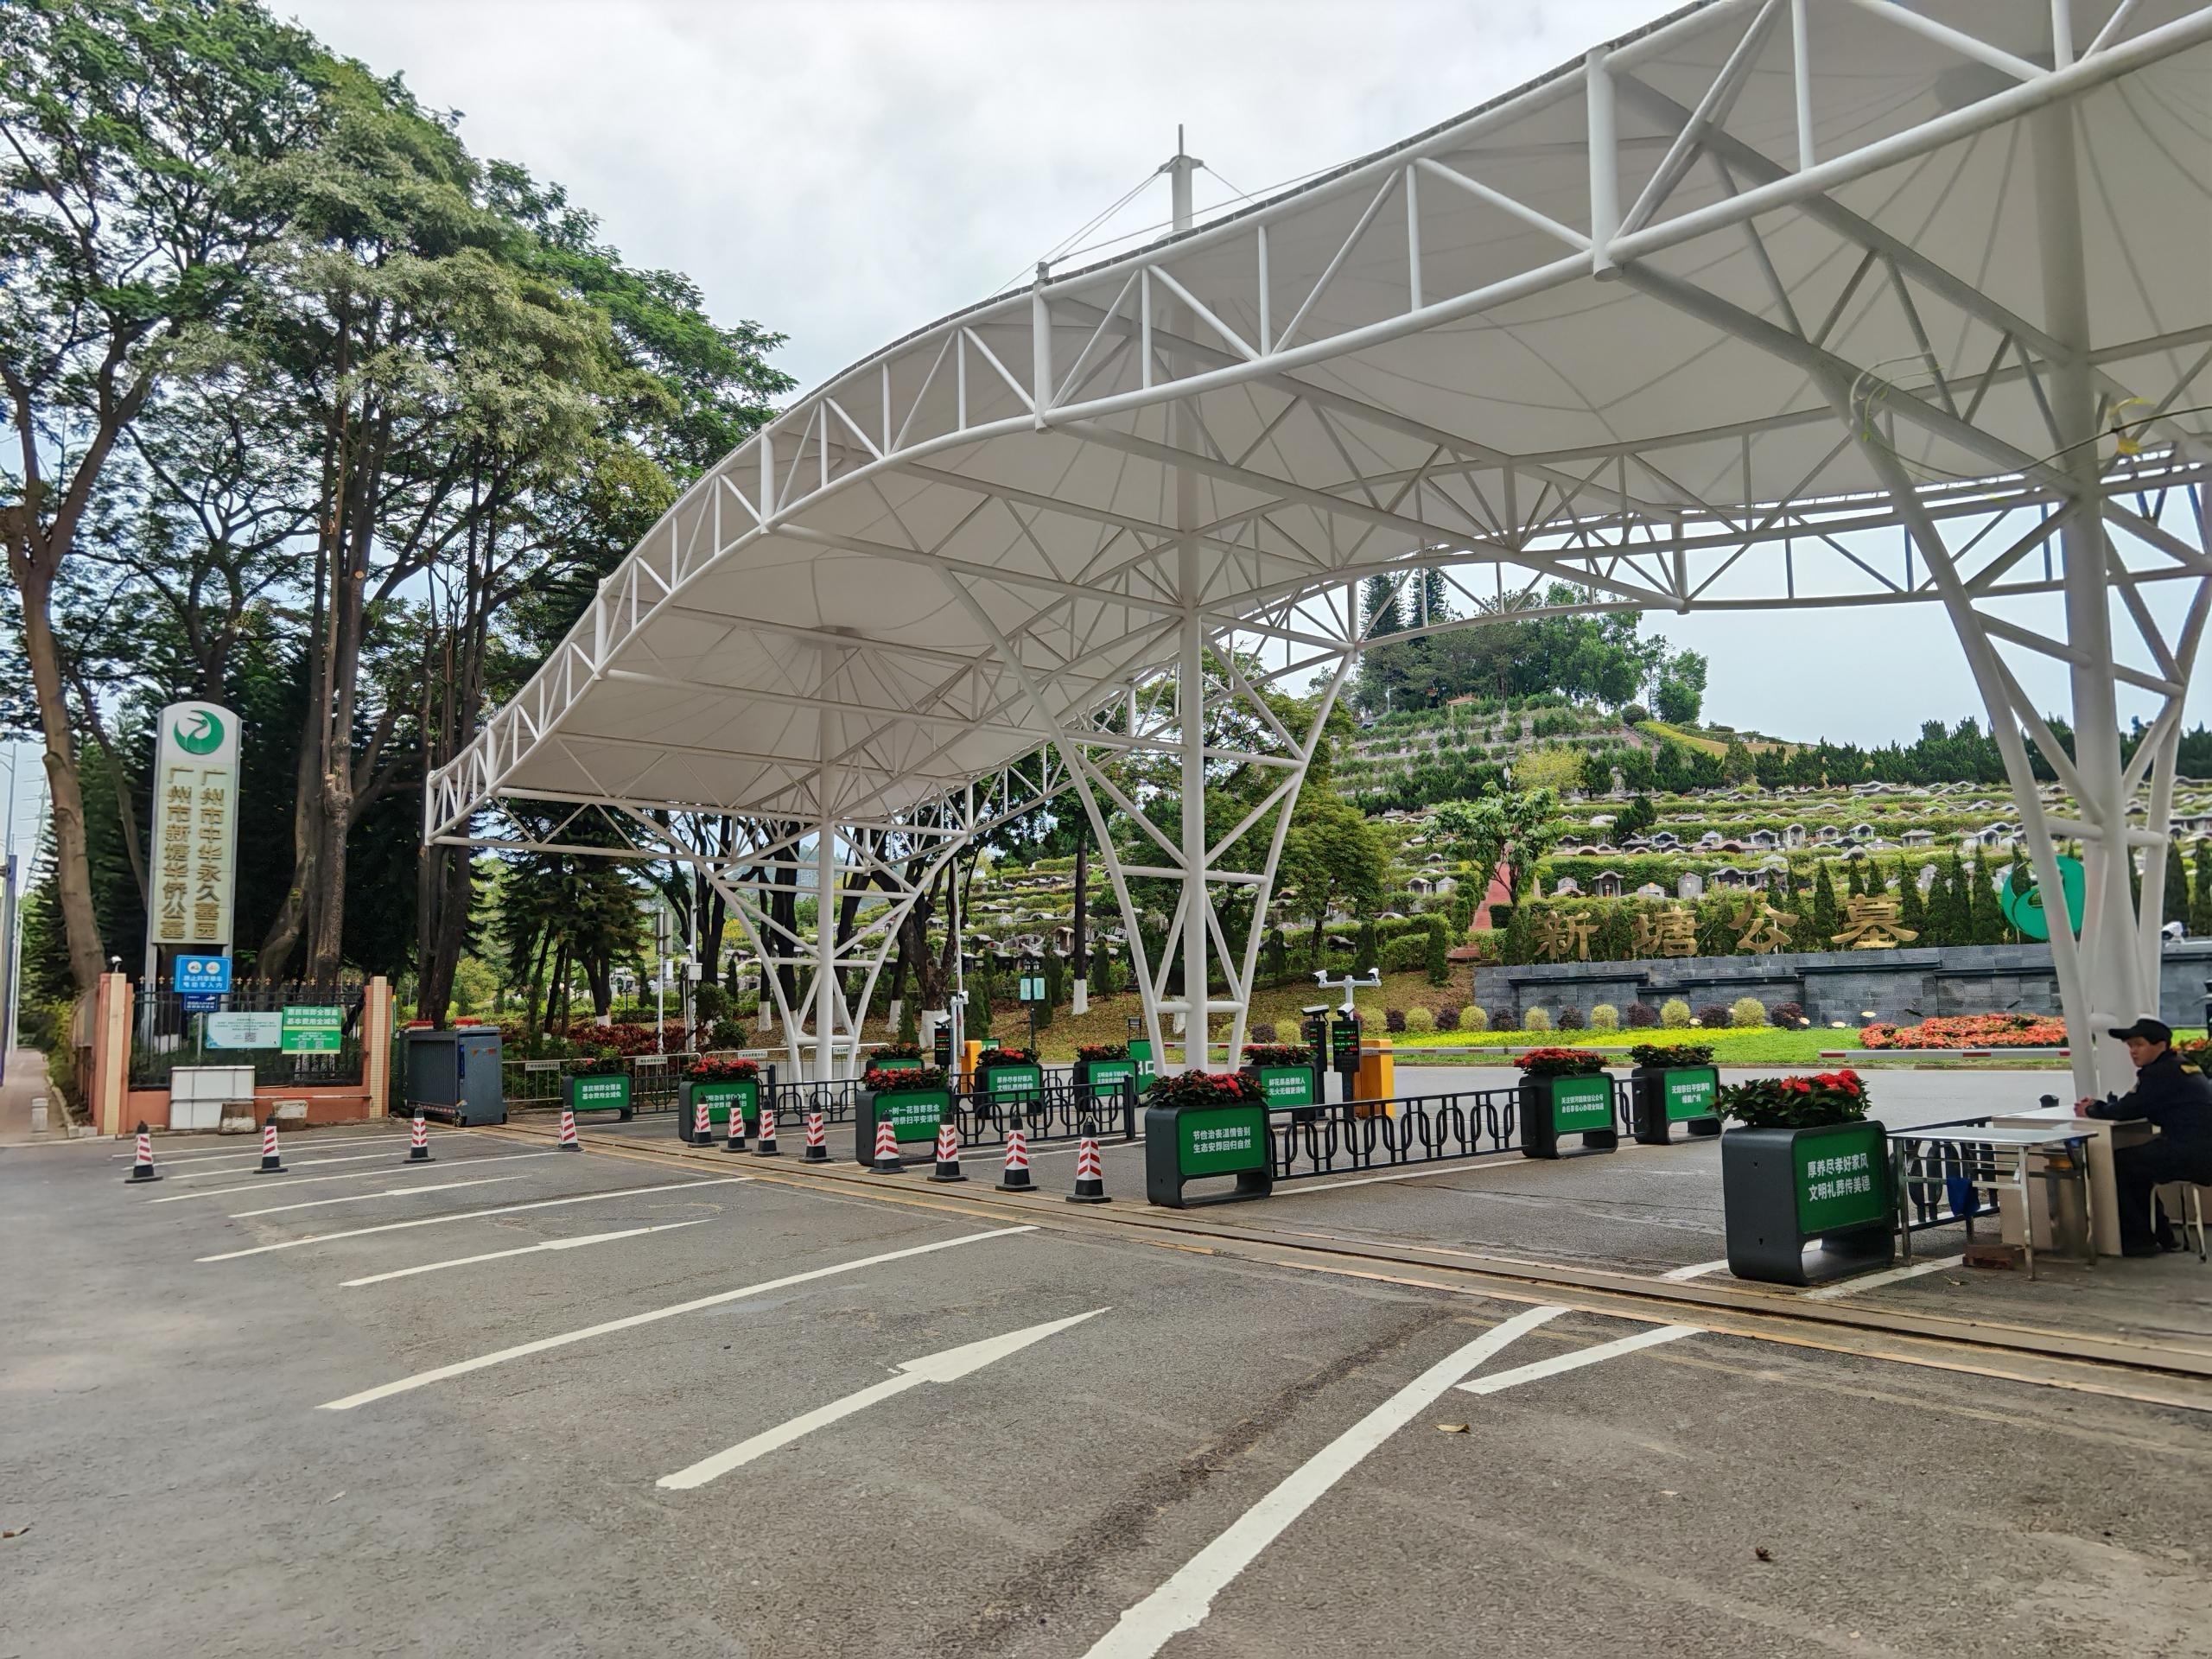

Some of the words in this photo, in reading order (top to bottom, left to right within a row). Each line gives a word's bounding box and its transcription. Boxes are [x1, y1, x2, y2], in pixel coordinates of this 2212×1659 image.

[160, 766, 194, 939] 广州市新塘华侨公墓
[194, 768, 227, 940] 广州市中华永久墓园
[1530, 893, 1919, 960] 新塘公墓
[890, 1114, 941, 1125] 明祭扫平安清明
[1192, 1126, 1251, 1141] 节俭治丧温情告别
[1192, 1138, 1252, 1154] 生态安葬回归自然
[1807, 1152, 1869, 1179] 厚养尽孝好家风
[1808, 1174, 1871, 1202] 文明礼葬传美德
